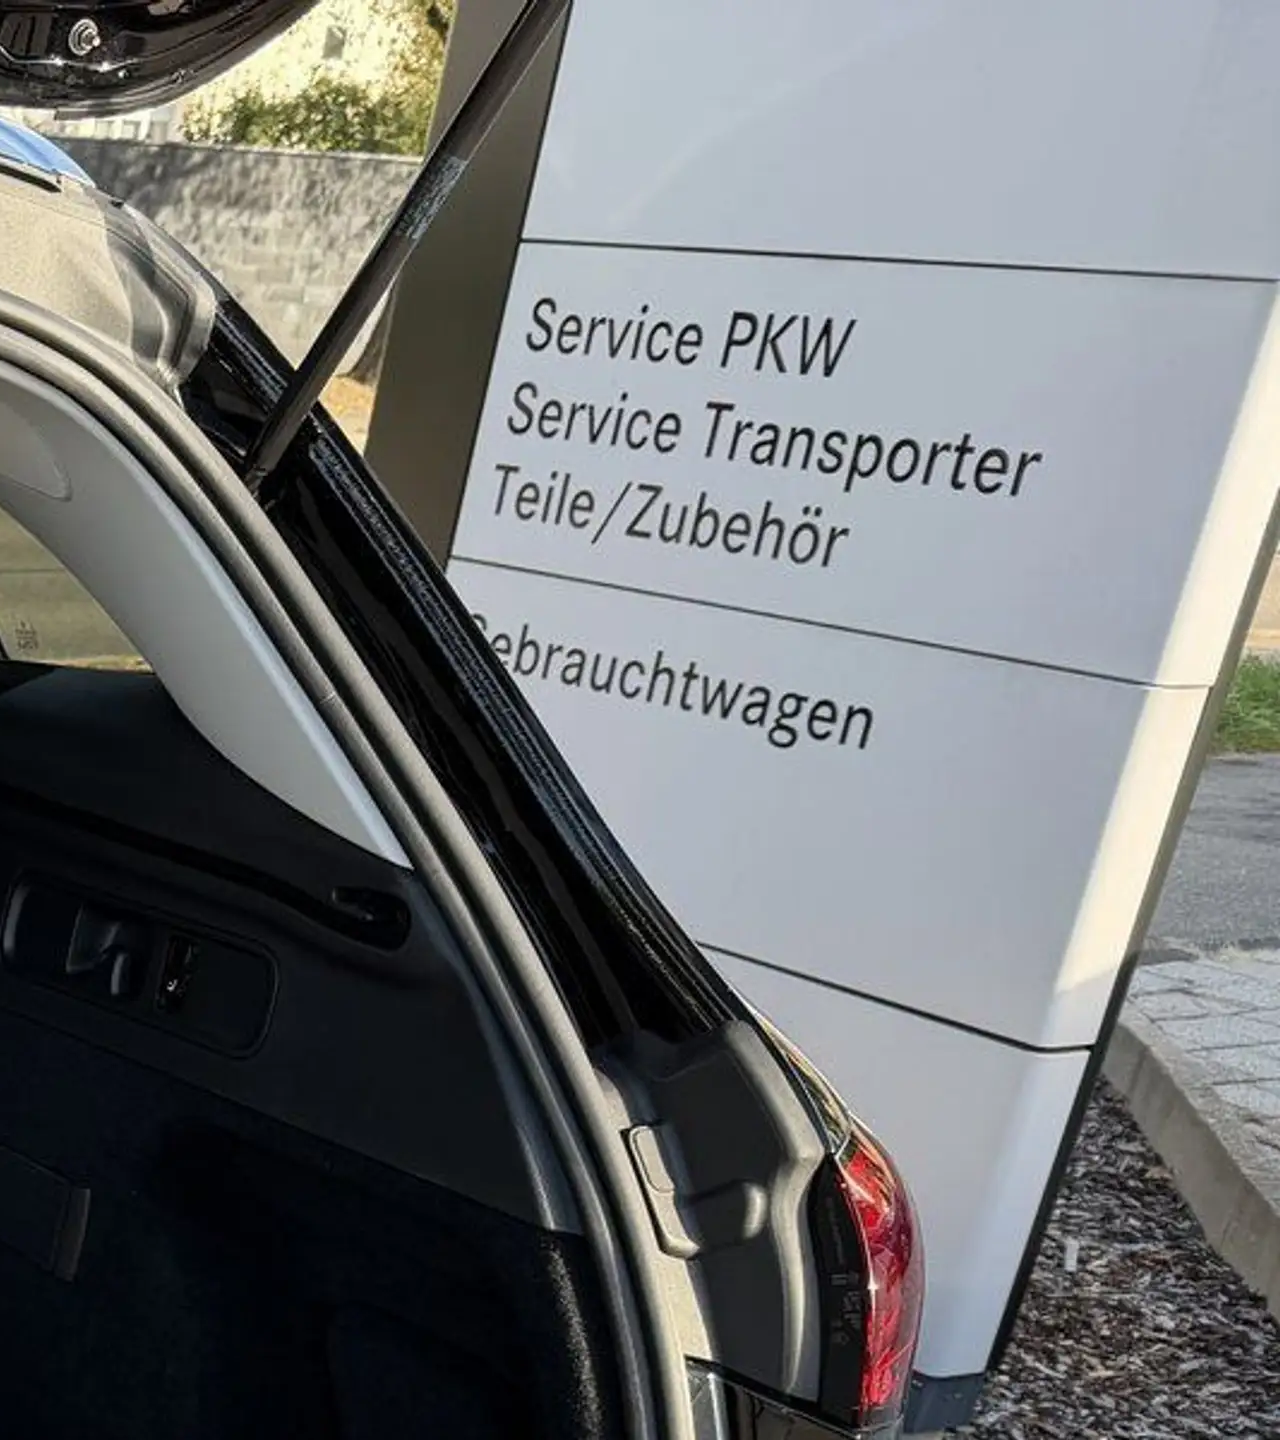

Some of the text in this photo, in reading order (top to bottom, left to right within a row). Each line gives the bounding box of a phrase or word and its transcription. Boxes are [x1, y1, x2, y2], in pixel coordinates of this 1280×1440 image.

[525, 296, 858, 378] Service PKW
[506, 381, 1044, 498] Service Transporter
[493, 463, 851, 569] Teile/Zubehör
[473, 612, 875, 751] ebrauchtwagen
